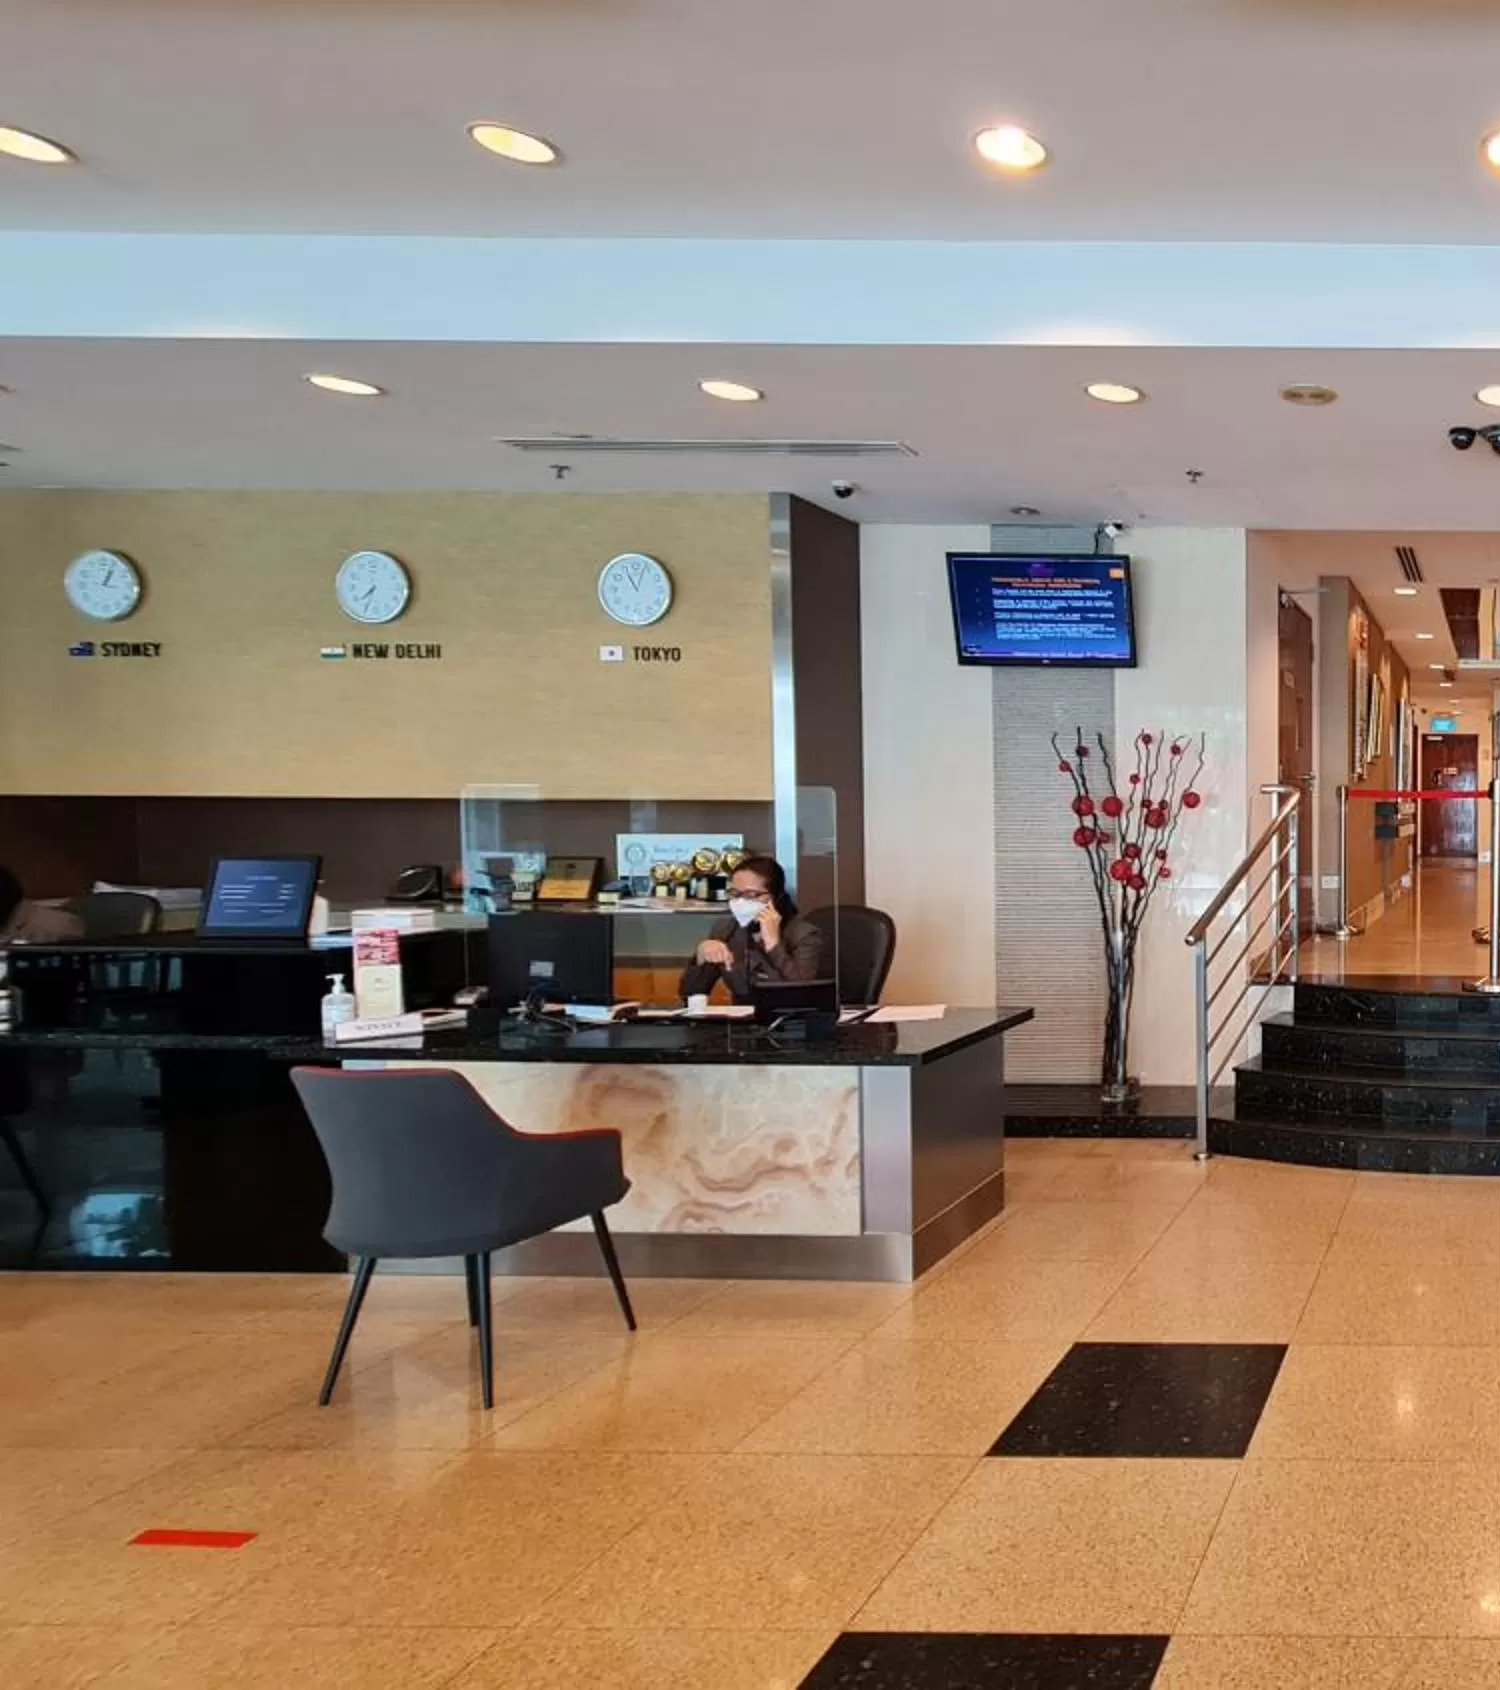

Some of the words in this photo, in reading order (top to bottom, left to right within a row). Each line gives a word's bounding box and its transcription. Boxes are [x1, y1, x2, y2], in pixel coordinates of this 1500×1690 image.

[101, 641, 162, 657] SYDNEY
[352, 642, 389, 659] NEW
[395, 642, 442, 659] DELHI
[633, 646, 681, 662] TOKYO
